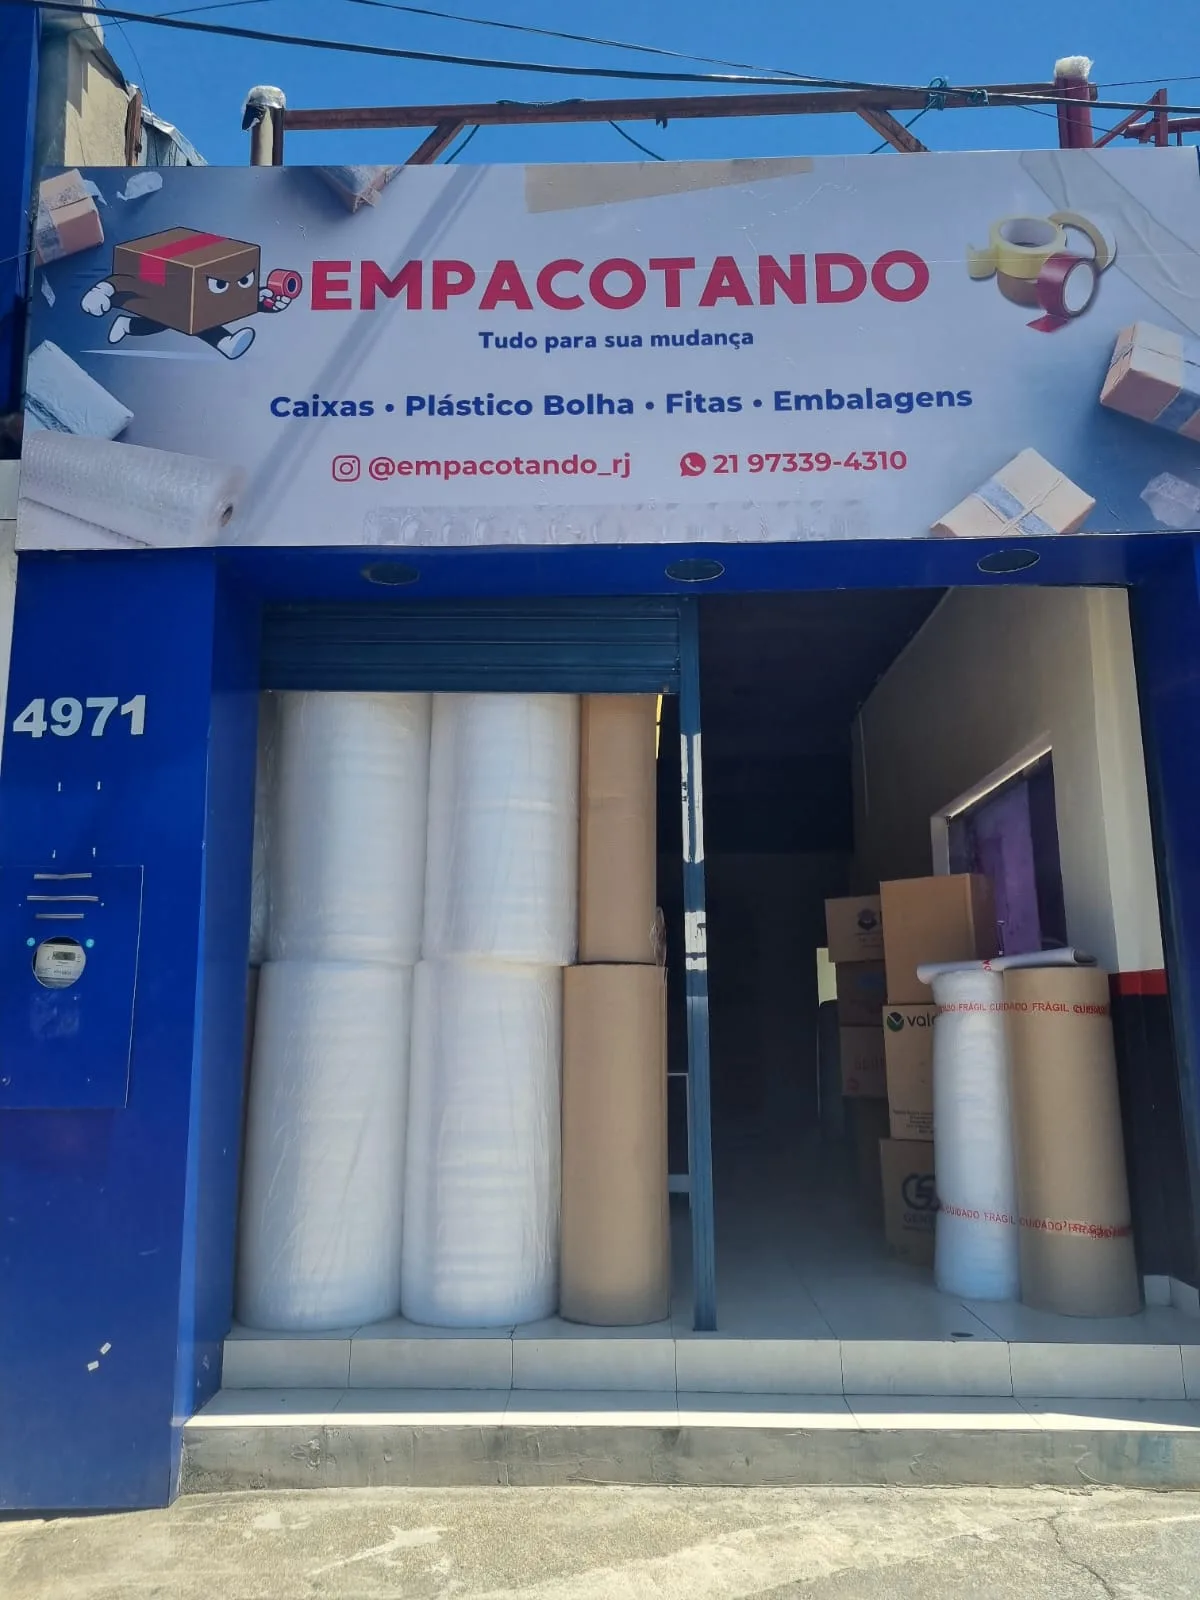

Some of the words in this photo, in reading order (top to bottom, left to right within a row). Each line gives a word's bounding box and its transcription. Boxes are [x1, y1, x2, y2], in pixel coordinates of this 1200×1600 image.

[311, 251, 929, 311] EMPACOTANDO
[479, 331, 537, 349] Tudo
[545, 336, 597, 354] para
[605, 335, 643, 349] sua
[651, 329, 754, 350] mudança
[270, 393, 375, 418] Caixas
[406, 392, 533, 417] Plástico
[544, 392, 635, 416] Bolha
[666, 390, 743, 414] Fitas
[775, 387, 973, 414] Embalagens
[369, 452, 631, 481] @empacotando_rj
[714, 455, 738, 474] 21
[747, 451, 907, 473] 97339-4310
[13, 695, 147, 737] 4971
